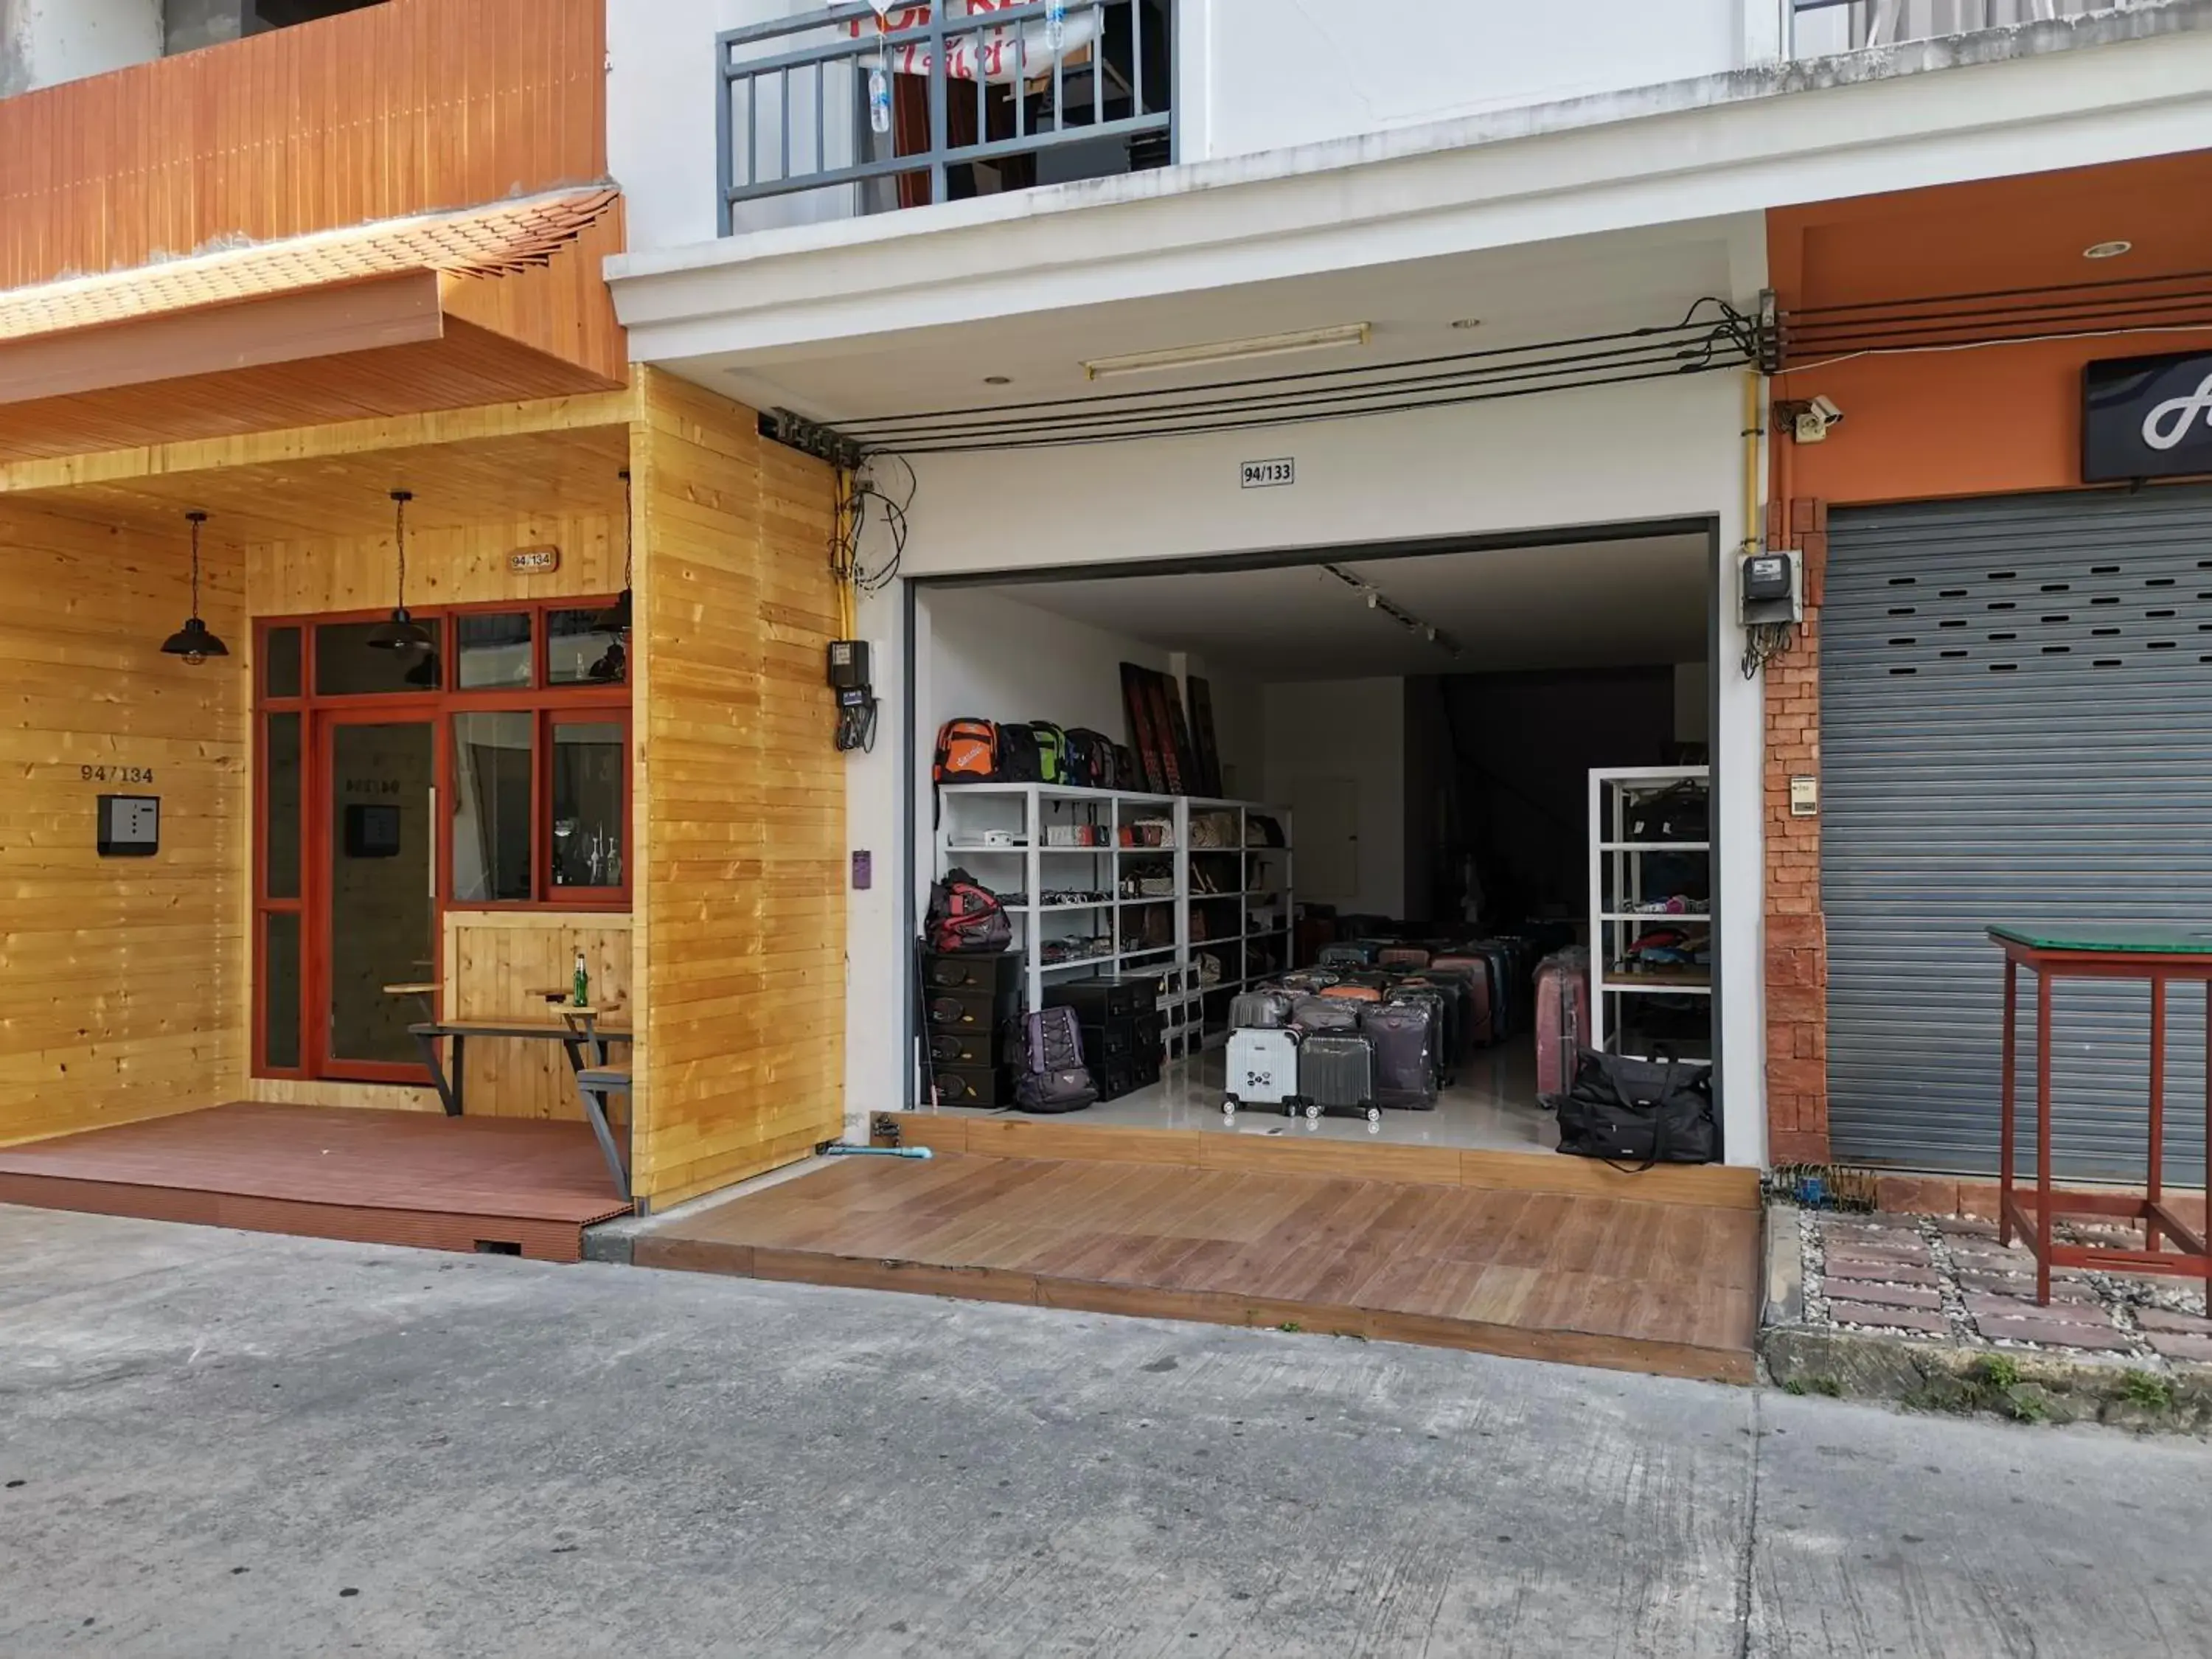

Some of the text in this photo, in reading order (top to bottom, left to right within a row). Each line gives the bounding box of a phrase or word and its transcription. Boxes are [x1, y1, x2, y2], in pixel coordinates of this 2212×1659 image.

[1244, 464, 1290, 482] 94/133
[512, 554, 549, 567] 94/134
[81, 765, 153, 783] 94/134
